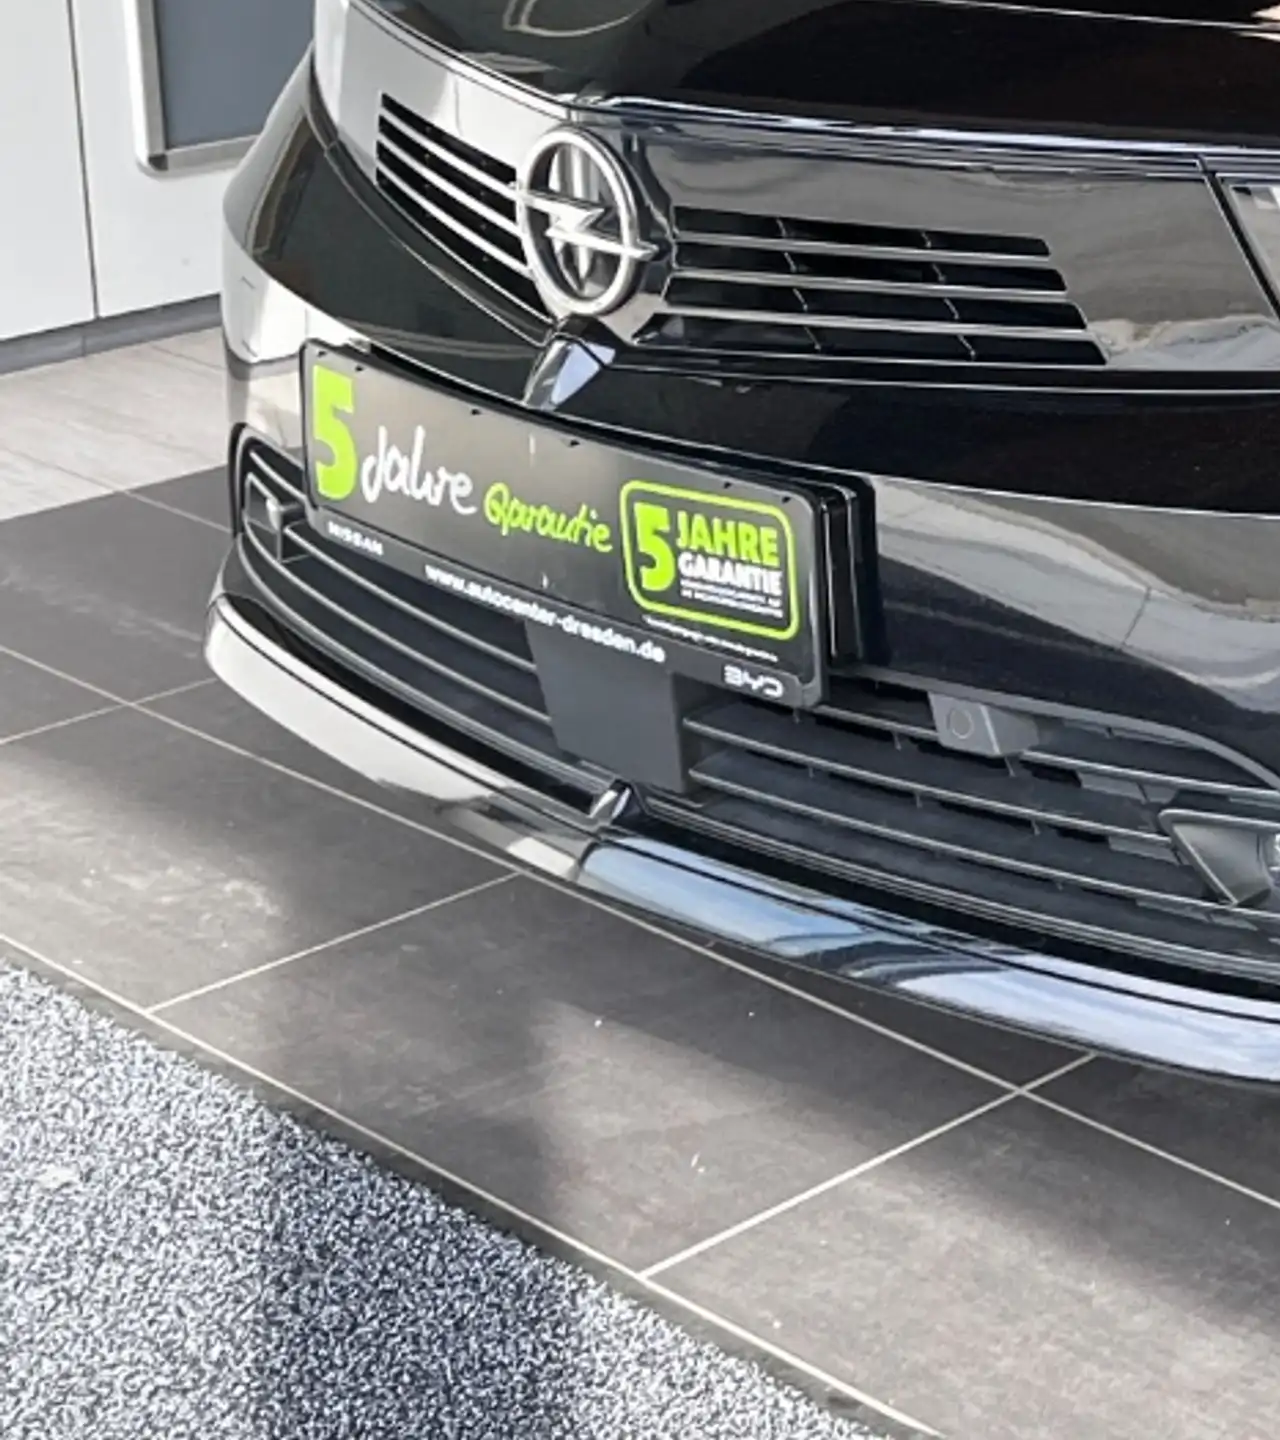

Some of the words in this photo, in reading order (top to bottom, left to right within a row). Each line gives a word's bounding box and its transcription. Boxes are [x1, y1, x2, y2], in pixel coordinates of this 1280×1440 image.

[313, 364, 358, 501] 5
[361, 425, 478, 515] Jahre
[484, 482, 613, 552] Garantie
[328, 520, 384, 556] NISSAN
[633, 502, 676, 592] 5
[676, 511, 780, 567] JAHRE
[677, 551, 783, 596] GARANTIE
[425, 564, 666, 663] www.autocenter-dresden.de
[724, 664, 784, 707] BYD
